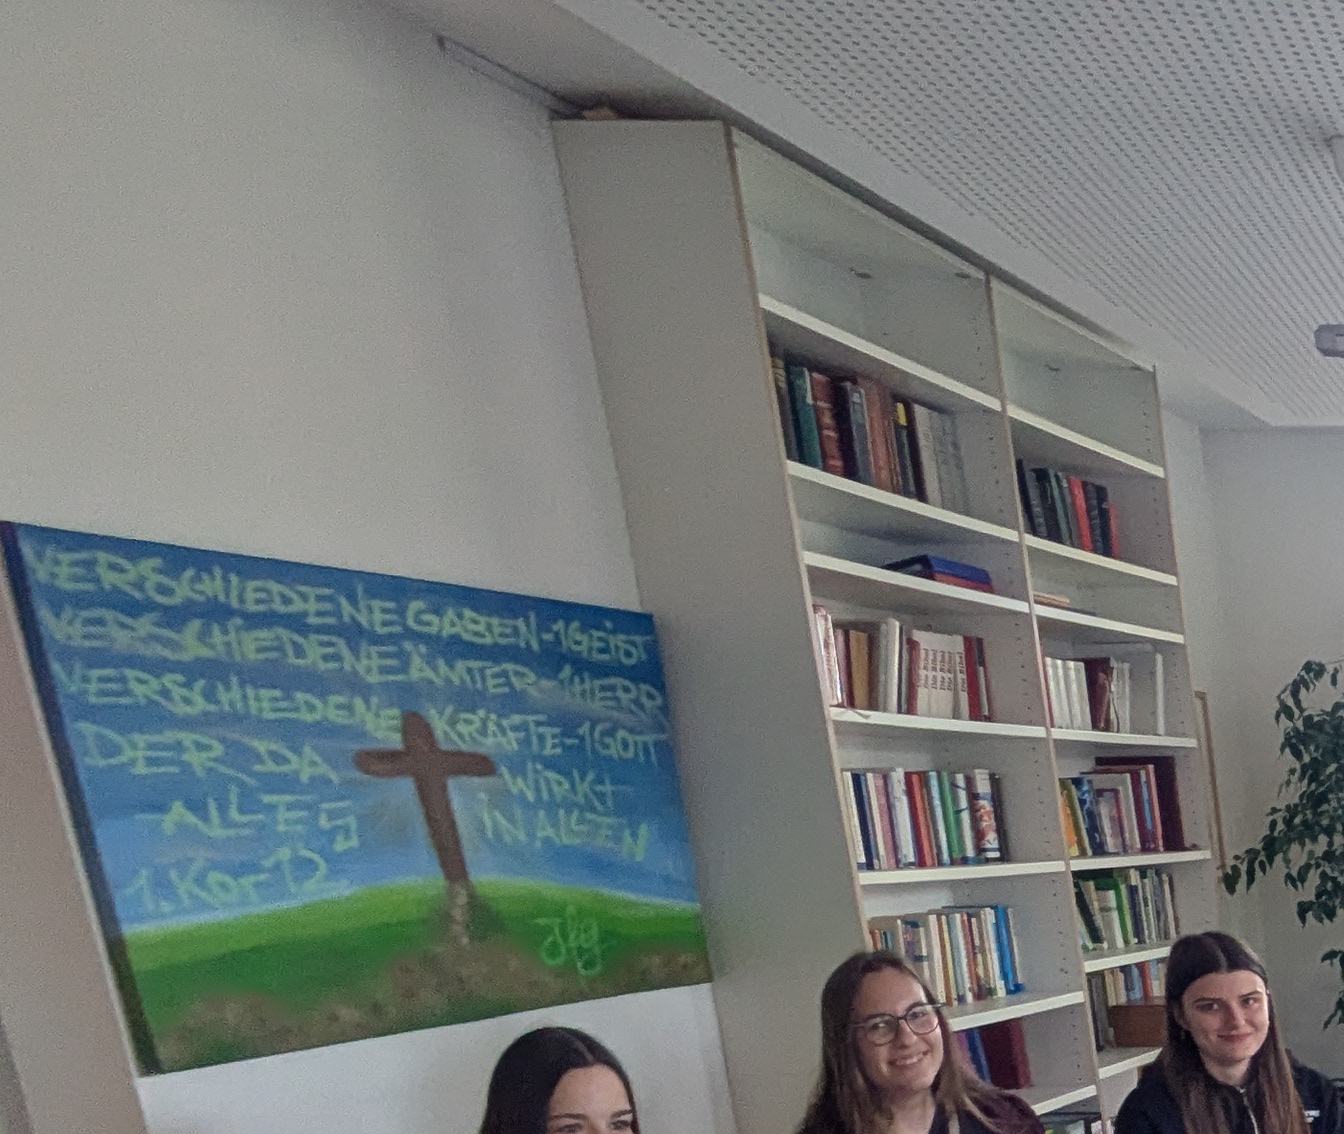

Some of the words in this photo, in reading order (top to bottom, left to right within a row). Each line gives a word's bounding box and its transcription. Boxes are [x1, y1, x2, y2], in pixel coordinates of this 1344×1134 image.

[26, 547, 402, 635] VERSCHIEDENE
[74, 722, 257, 786] DER
[254, 740, 342, 784] DA
[158, 784, 360, 854] ALLES
